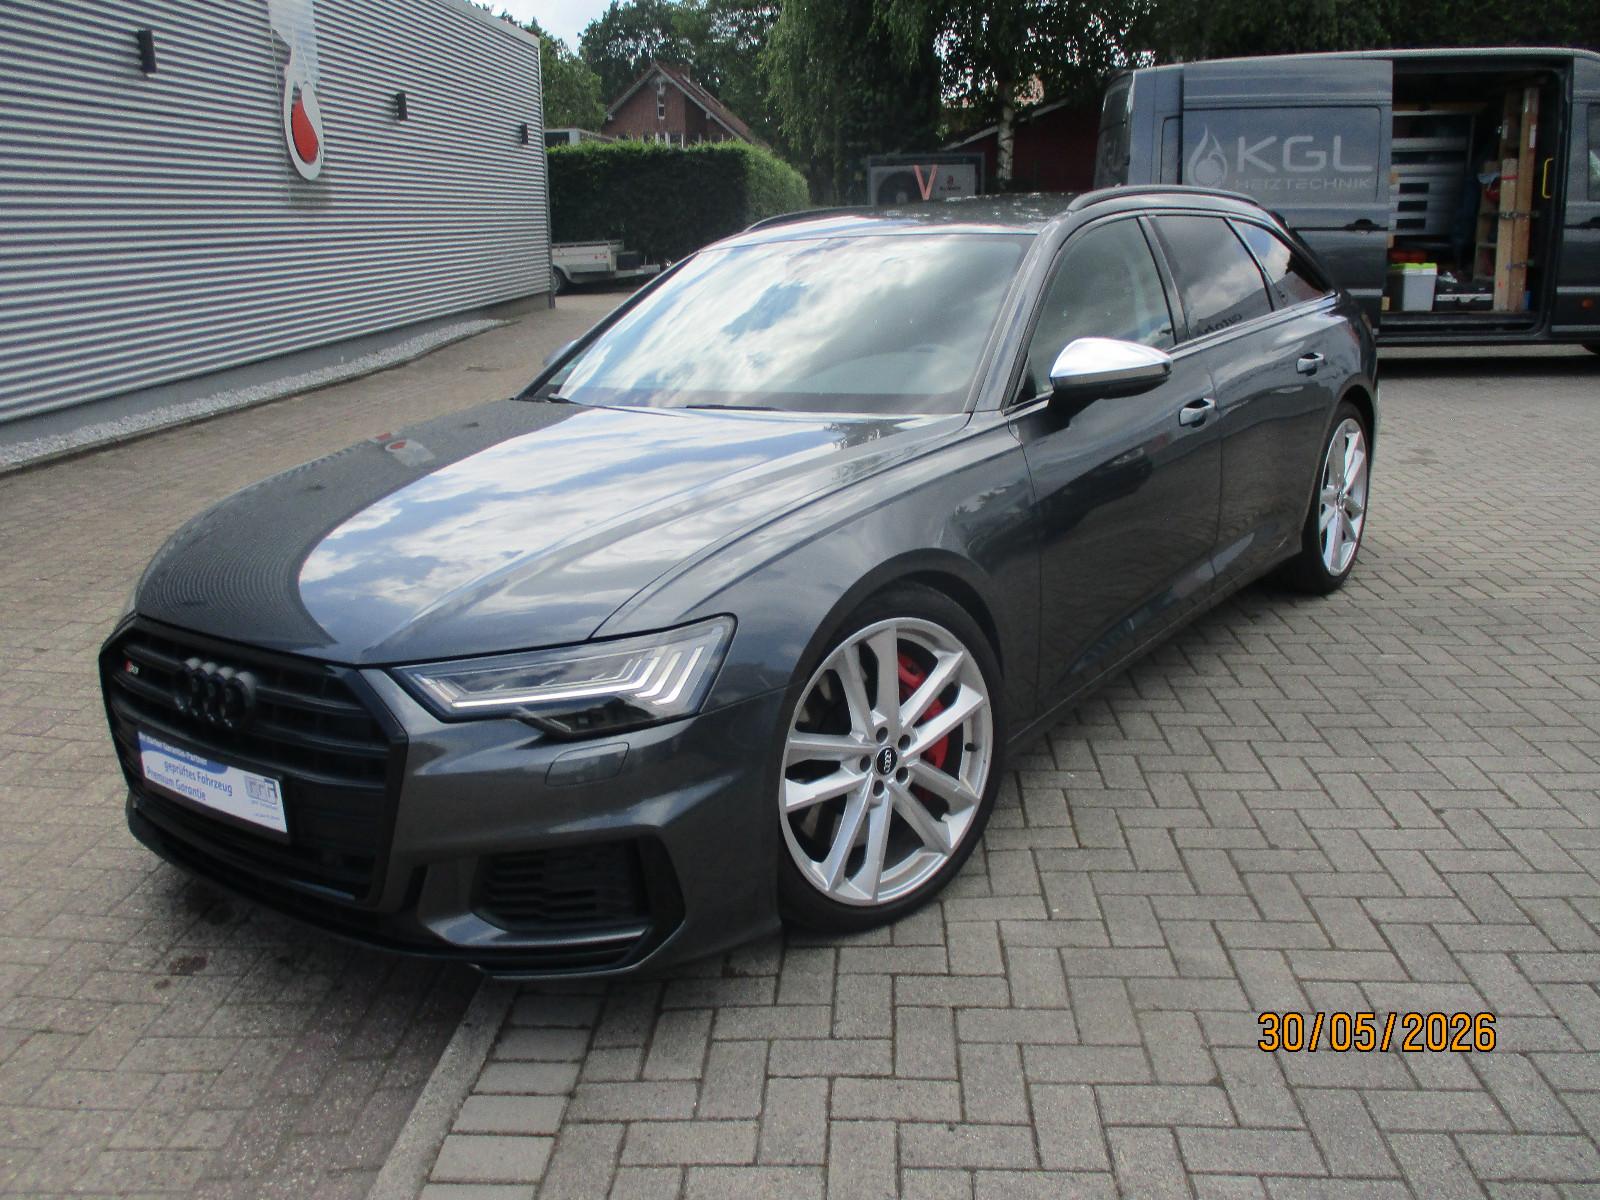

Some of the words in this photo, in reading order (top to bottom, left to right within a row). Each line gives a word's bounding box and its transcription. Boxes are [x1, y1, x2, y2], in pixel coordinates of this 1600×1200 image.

[1237, 135, 1374, 173] KGL
[1236, 177, 1371, 191] HEIZTECHNIK
[147, 765, 174, 787] Premium
[175, 778, 206, 801] Garantie
[164, 760, 196, 782] geprüftes
[197, 771, 233, 797] Fahrzeug
